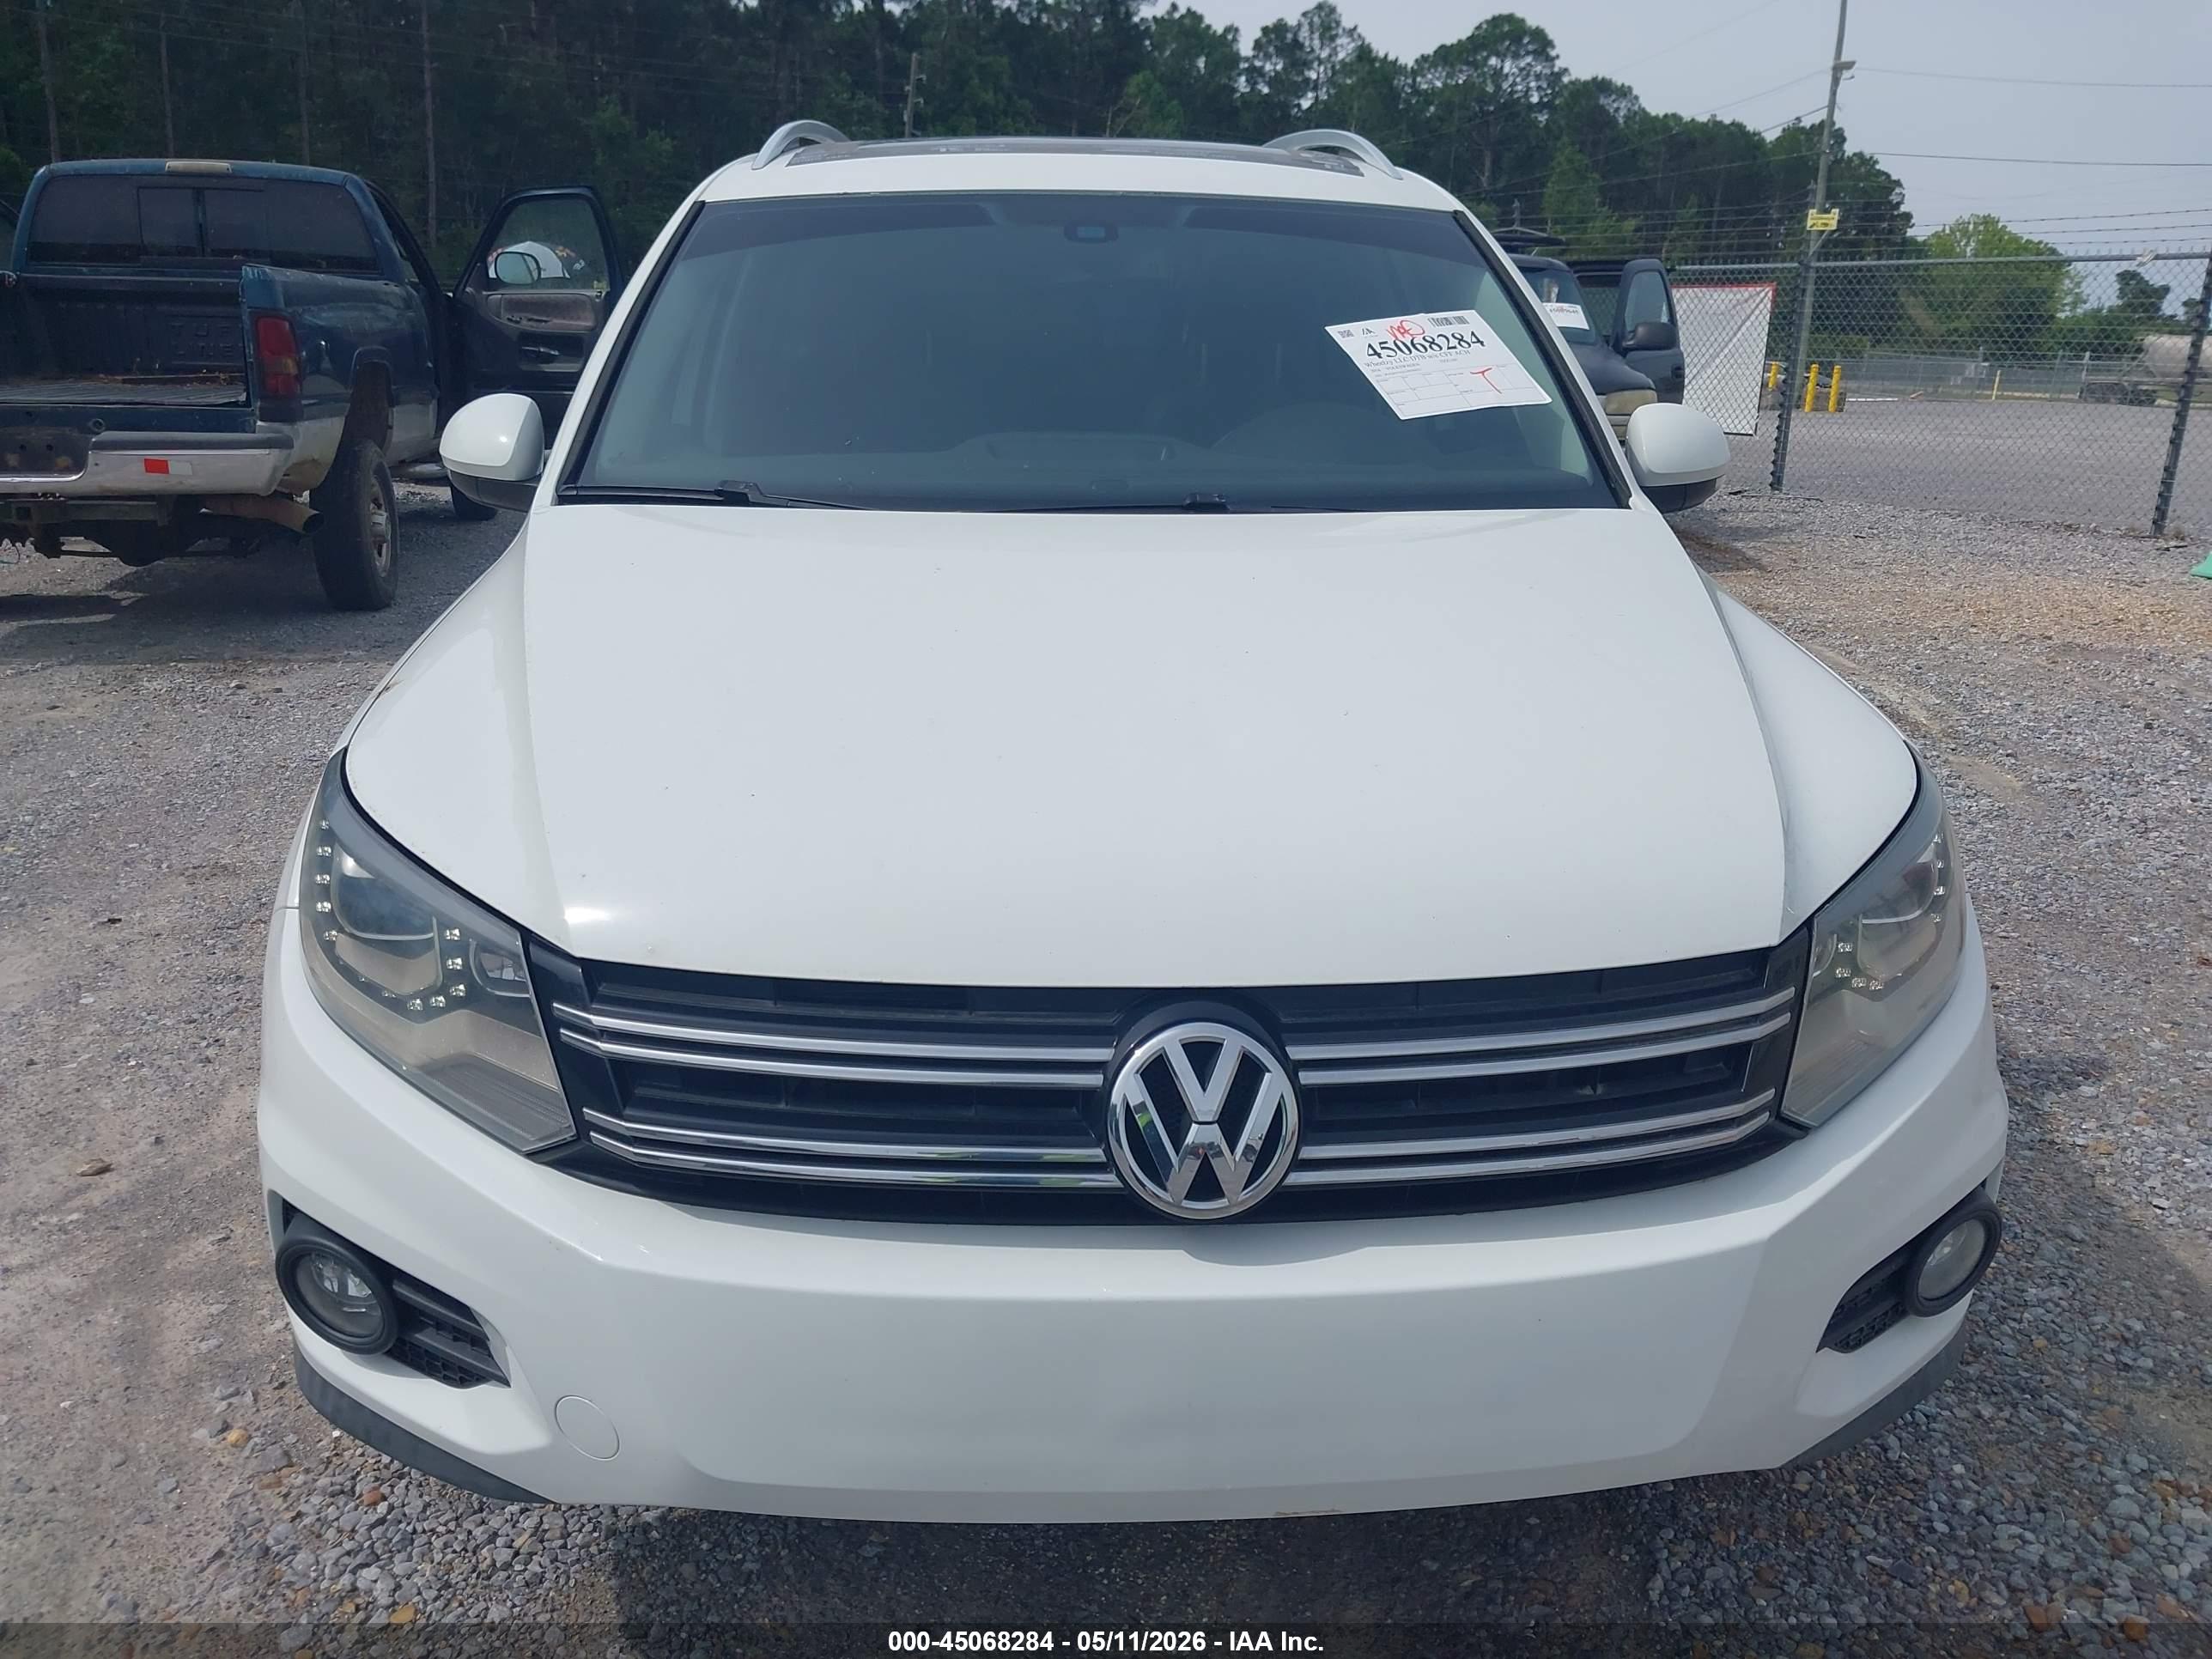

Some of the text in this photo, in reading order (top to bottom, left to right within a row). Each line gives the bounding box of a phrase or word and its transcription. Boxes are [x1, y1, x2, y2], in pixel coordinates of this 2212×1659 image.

[1366, 331, 1486, 359] 45068284
[1470, 368, 1502, 394] T
[1109, 1023, 1298, 1219] VW
